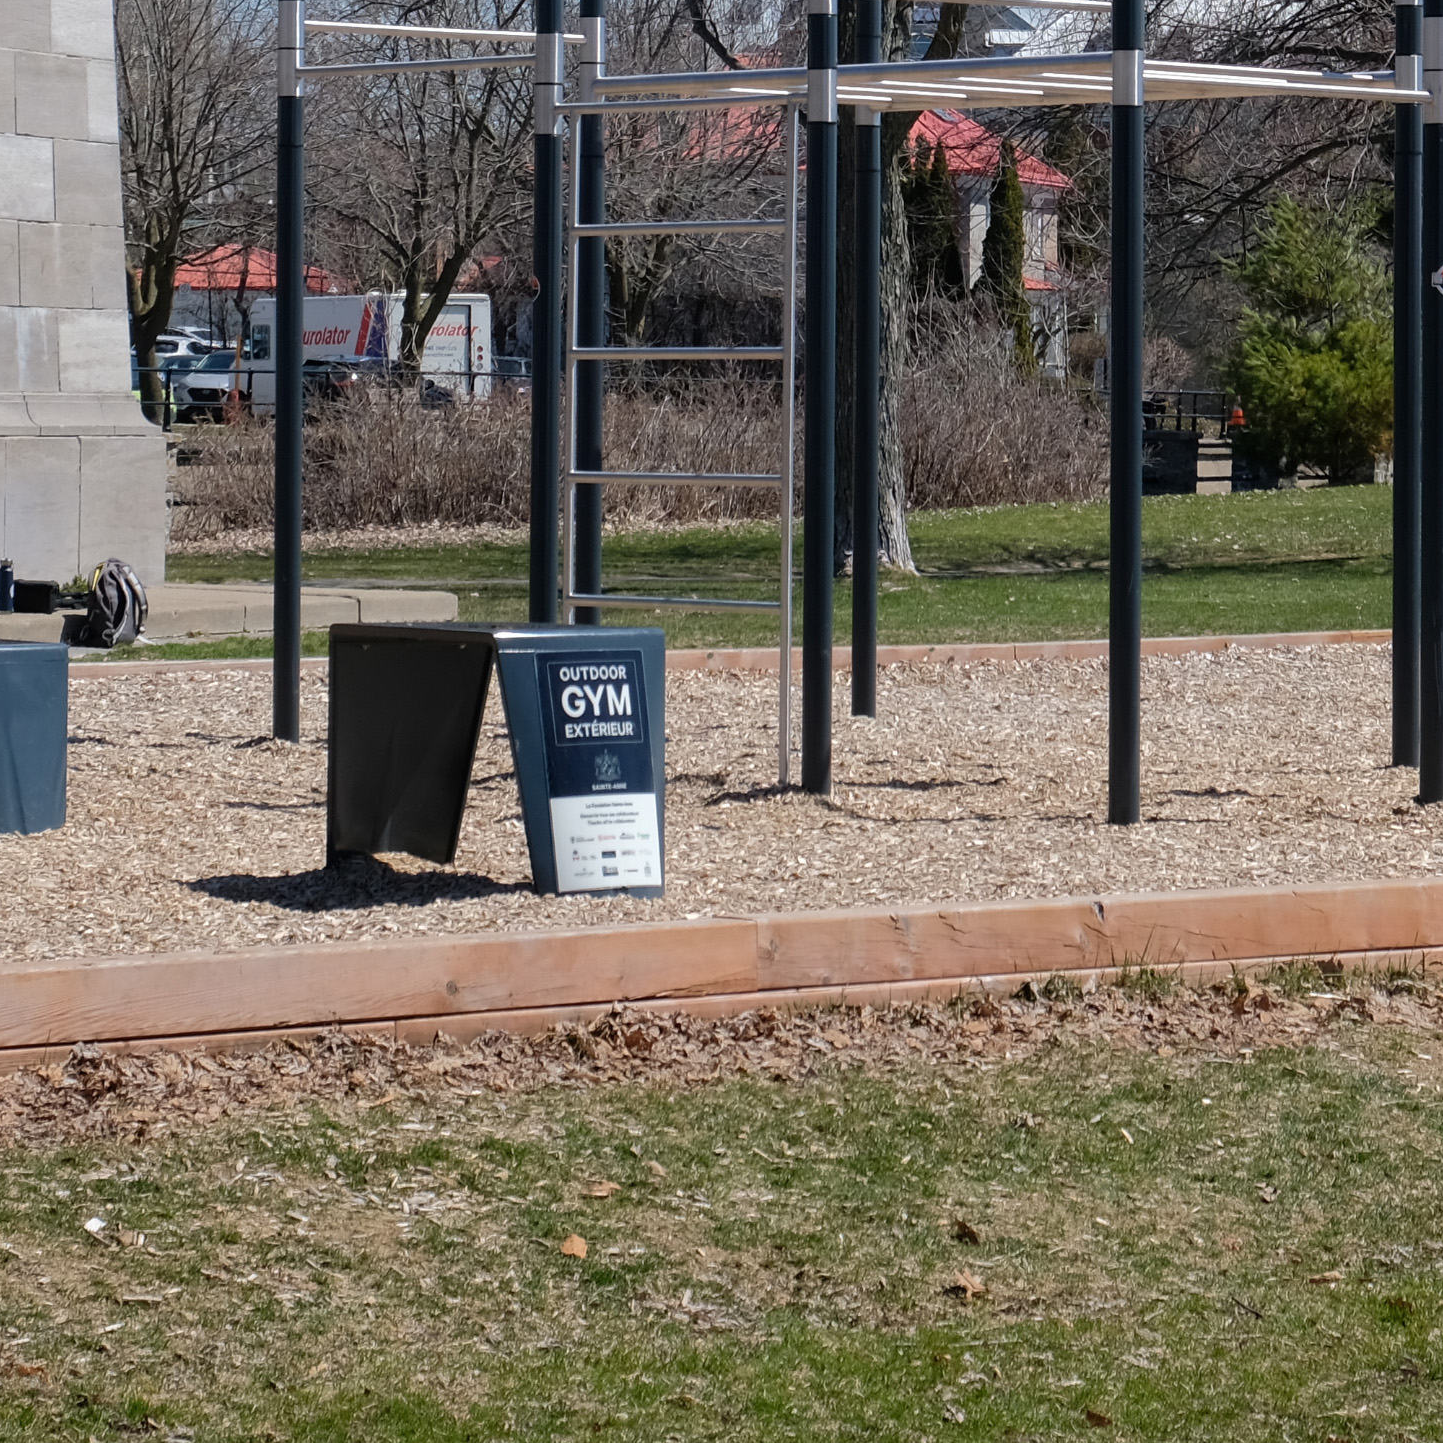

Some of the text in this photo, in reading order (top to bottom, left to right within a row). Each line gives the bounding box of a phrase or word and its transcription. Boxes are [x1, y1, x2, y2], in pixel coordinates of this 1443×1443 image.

[302, 326, 351, 346] urolator
[429, 324, 478, 336] rolator
[559, 664, 627, 682] OUTDOOR
[561, 682, 632, 719] GYM
[564, 718, 634, 739] EXTÉRIEUR
